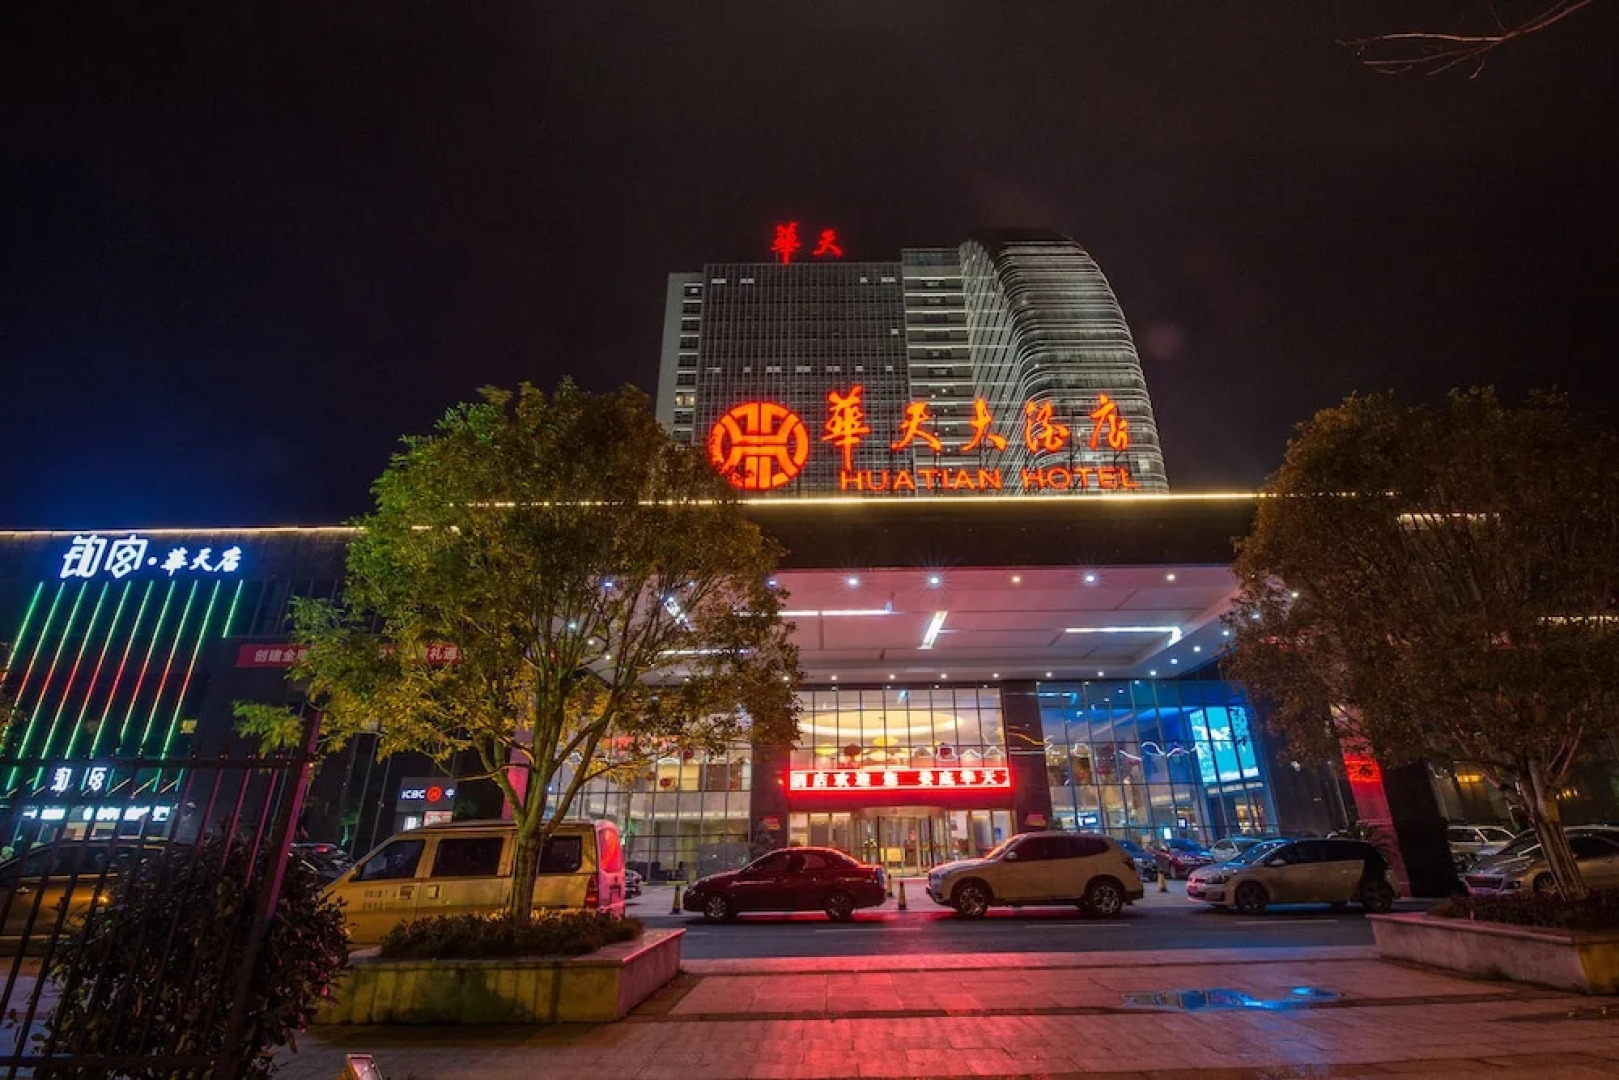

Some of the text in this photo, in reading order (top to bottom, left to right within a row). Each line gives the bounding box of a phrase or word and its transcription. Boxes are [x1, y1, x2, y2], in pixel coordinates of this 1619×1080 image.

[840, 468, 1139, 491] HUATIAN HOTEL
[401, 789, 426, 799] ICBC
